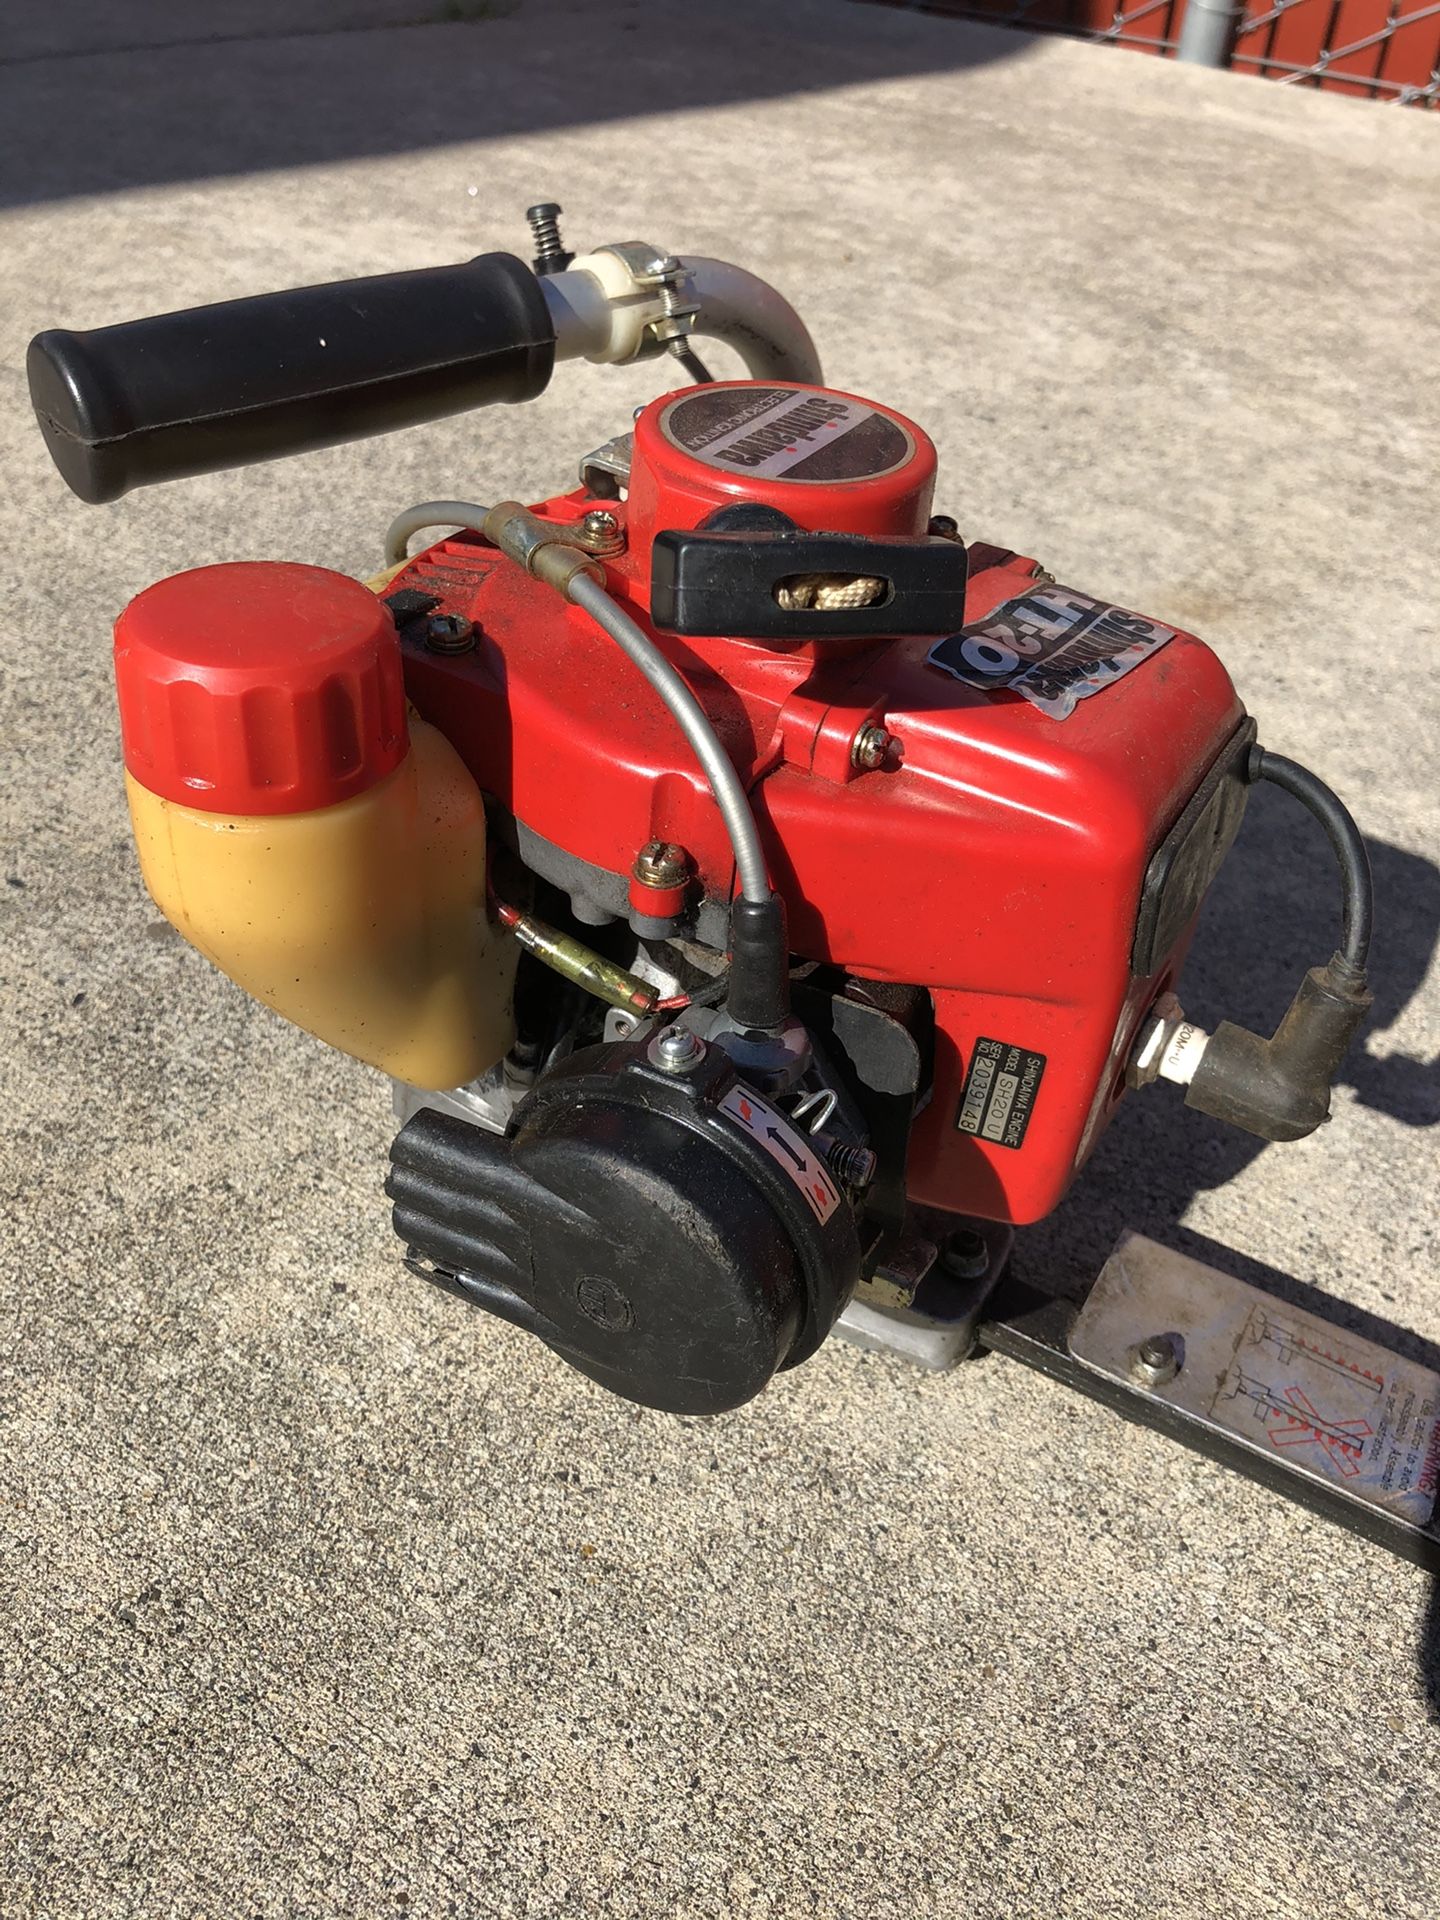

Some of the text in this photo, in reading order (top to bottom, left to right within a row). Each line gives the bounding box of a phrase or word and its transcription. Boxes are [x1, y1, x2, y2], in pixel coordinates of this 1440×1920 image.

[713, 397, 850, 467] shindaiwa
[960, 587, 1097, 676] HT-20
[989, 1041, 1003, 1060] SER
[1004, 1047, 1022, 1072] MODEL
[960, 1057, 994, 1130] 2039148
[991, 1077, 1014, 1119] SH20
[1004, 1057, 1041, 1146] SHINDAIWA ENGINE
